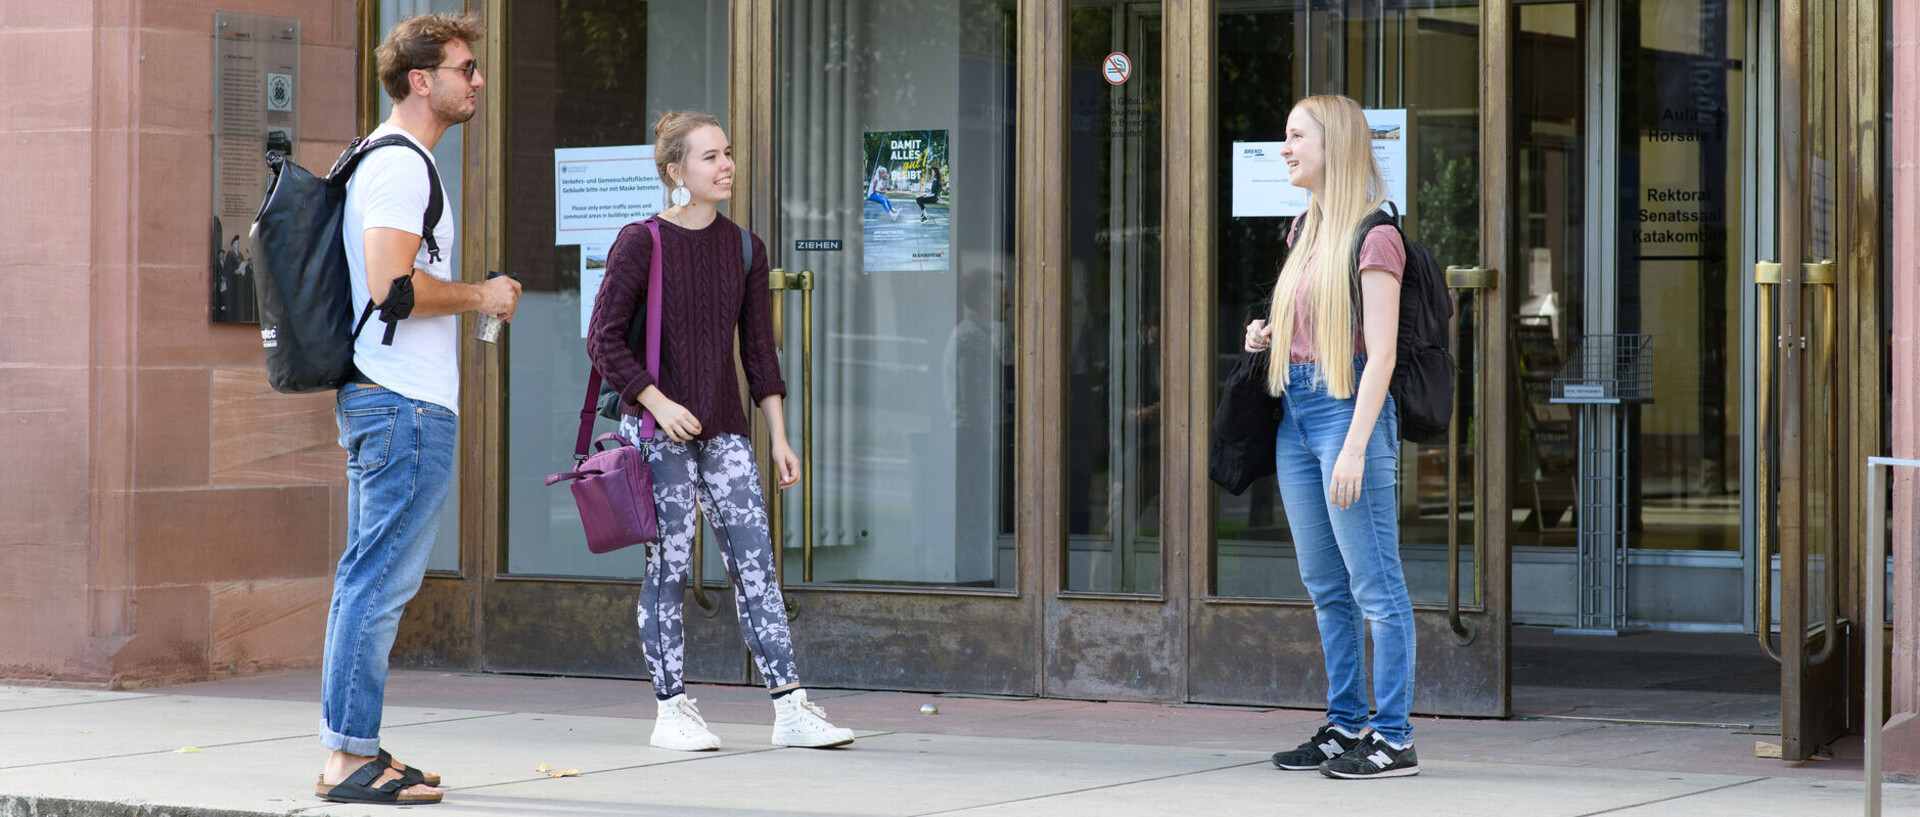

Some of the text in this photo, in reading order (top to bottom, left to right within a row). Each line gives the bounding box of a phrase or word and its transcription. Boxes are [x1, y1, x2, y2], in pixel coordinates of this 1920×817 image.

[1662, 108, 1698, 121] Aula
[1648, 128, 1708, 142] Hörsäle
[890, 140, 922, 150] DAMIT
[890, 150, 920, 160] ALLES
[902, 147, 929, 177] gut!
[1647, 188, 1712, 201] Rektorat
[1638, 208, 1721, 222] Senatssaal
[1632, 230, 1728, 243] Katakomben
[1318, 738, 1345, 760] N
[1366, 750, 1394, 769] N
